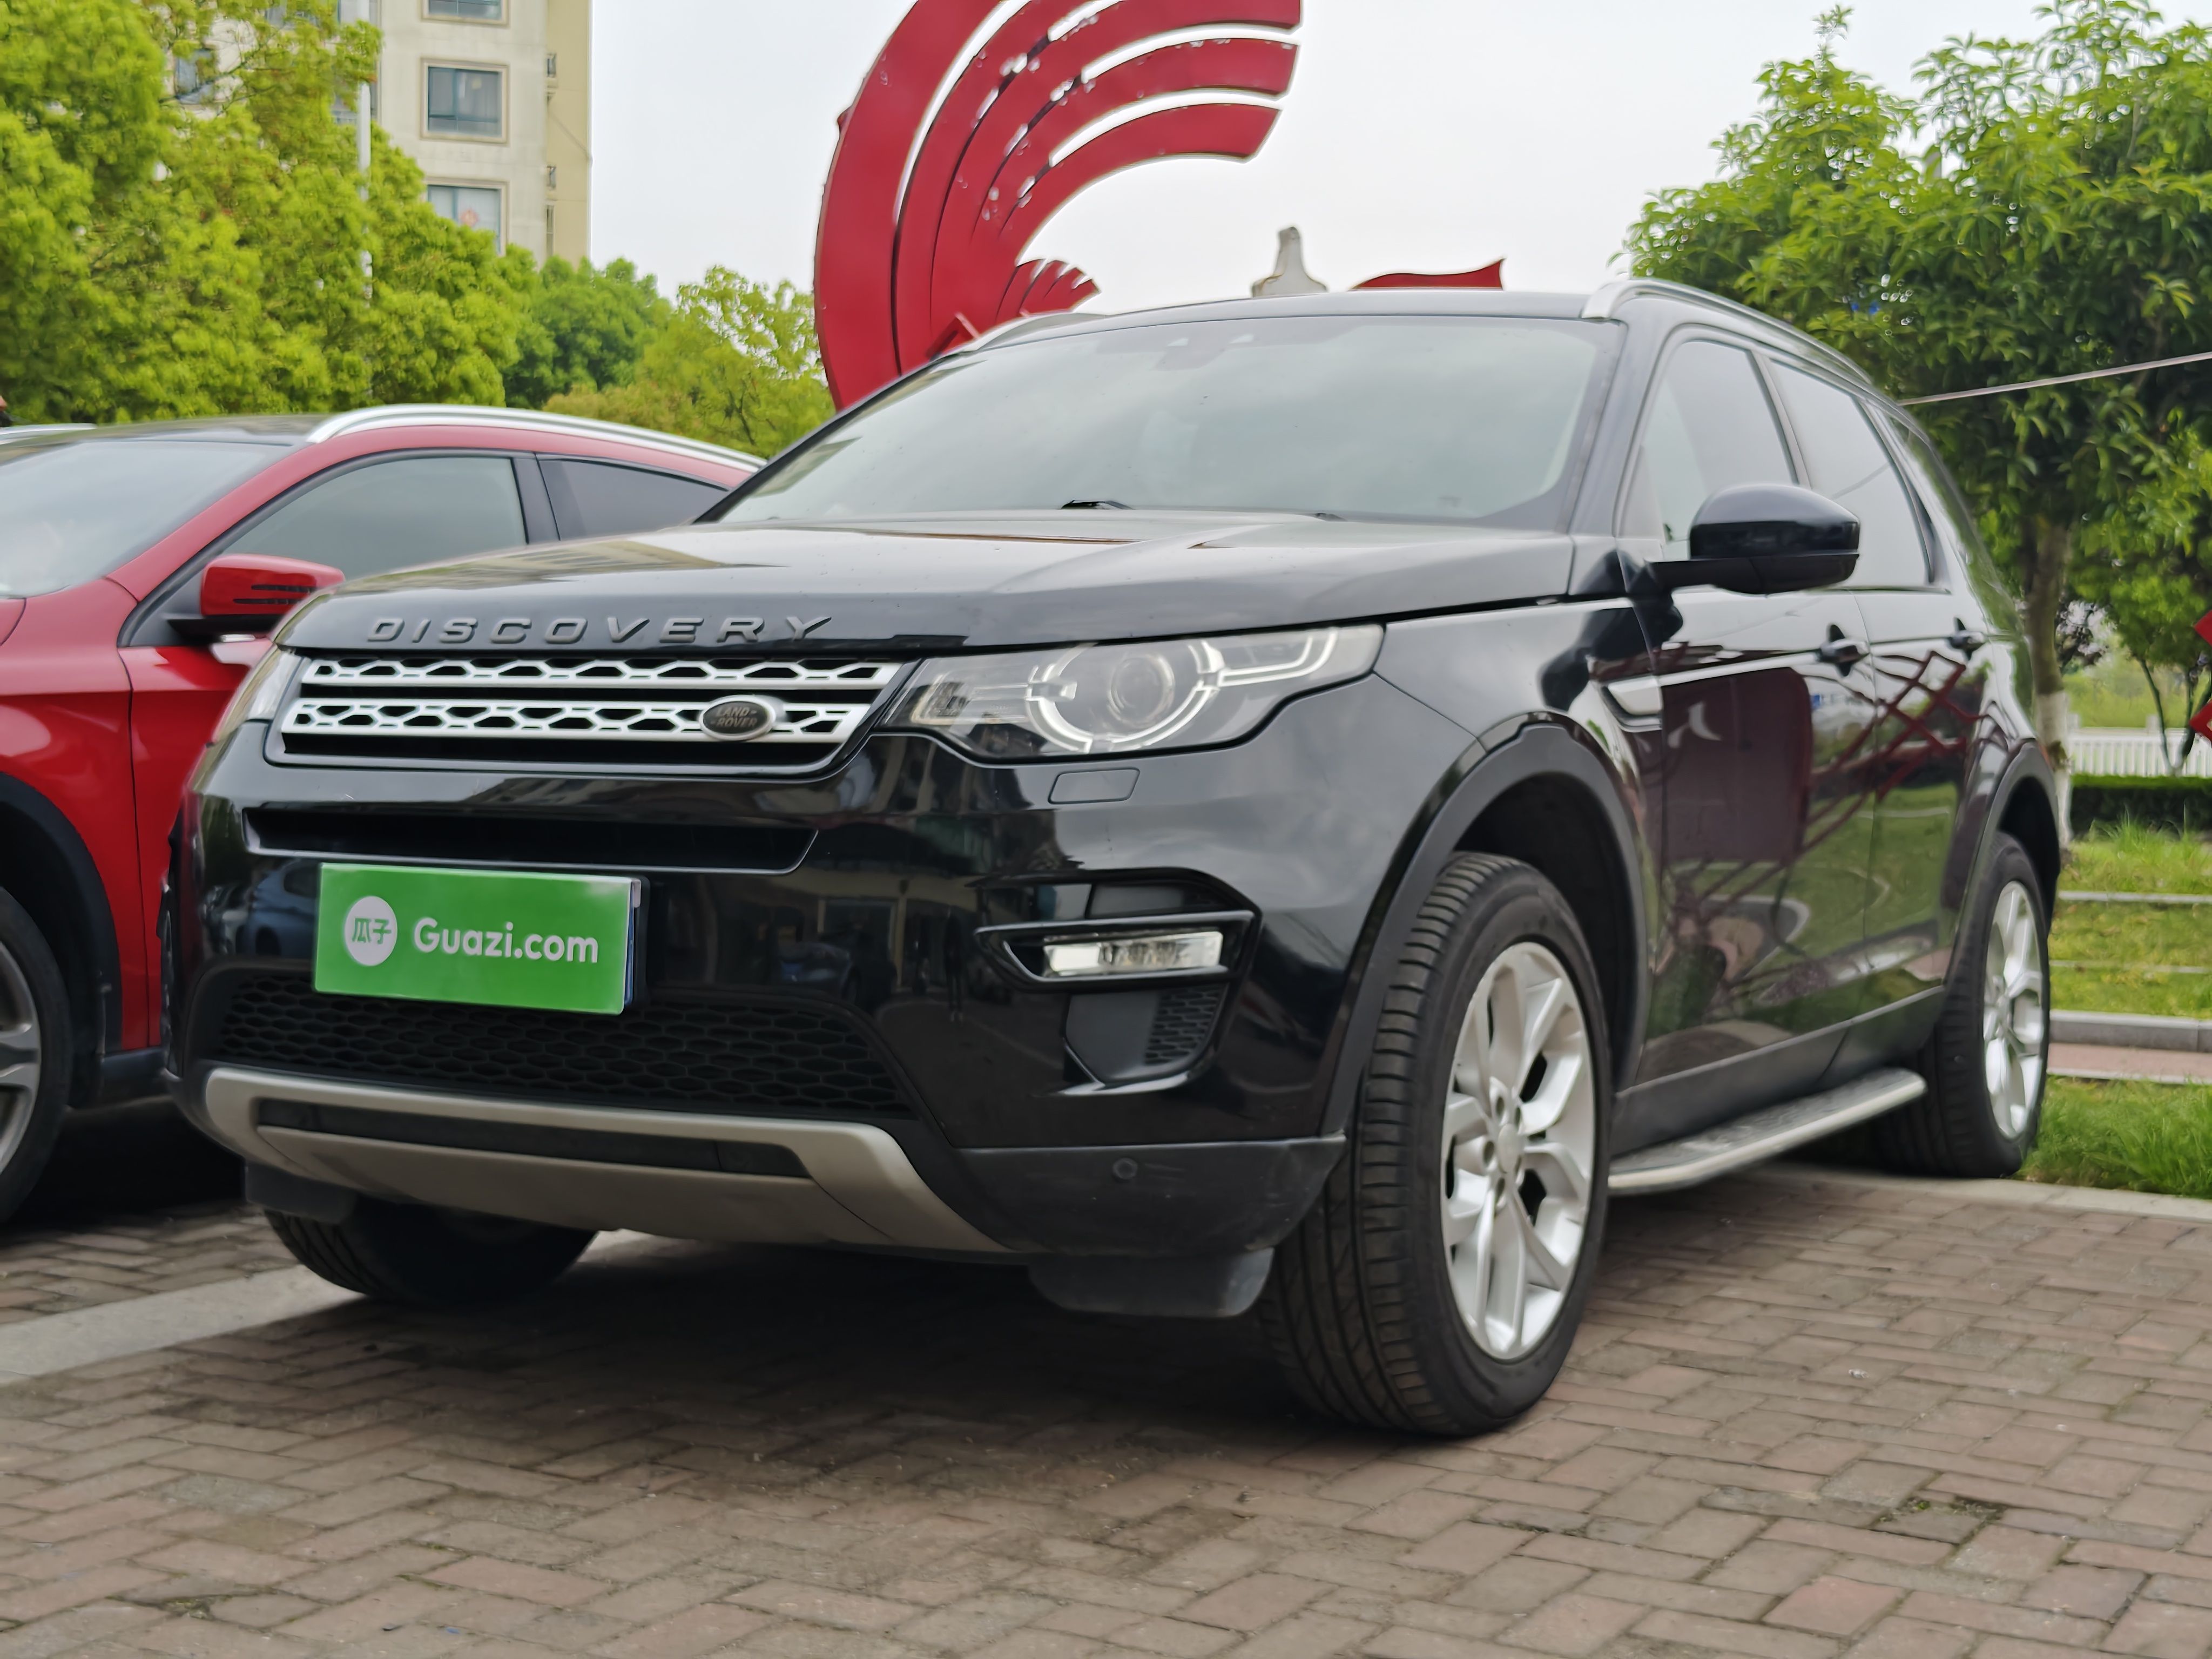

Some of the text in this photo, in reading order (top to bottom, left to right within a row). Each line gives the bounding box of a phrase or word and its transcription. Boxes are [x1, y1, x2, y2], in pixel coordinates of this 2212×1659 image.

[367, 616, 832, 644] DISCOVERY
[352, 917, 598, 963] 瓜子 Guazi.com
